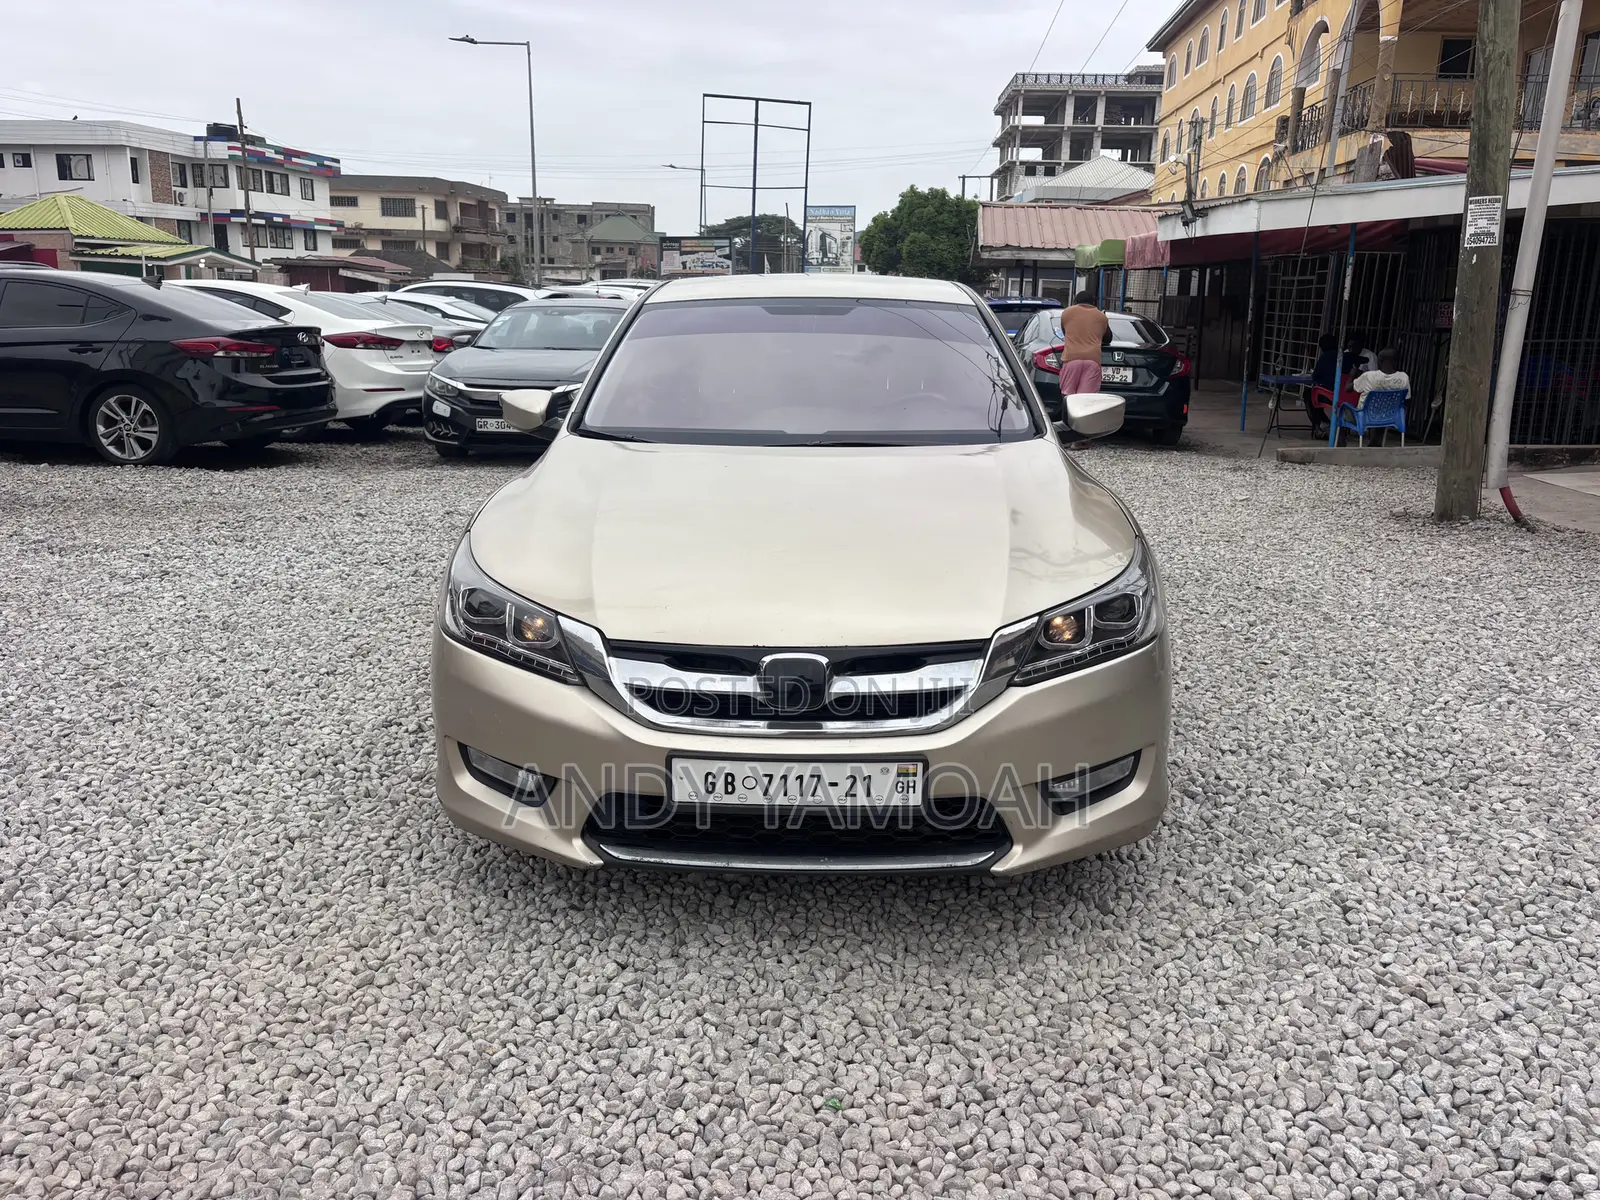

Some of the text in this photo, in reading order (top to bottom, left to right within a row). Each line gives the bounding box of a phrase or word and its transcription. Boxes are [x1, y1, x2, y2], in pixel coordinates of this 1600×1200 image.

[477, 420, 489, 430] GR
[704, 771, 737, 796] GB
[761, 773, 873, 798] 7117-21
[895, 780, 917, 795] GH
